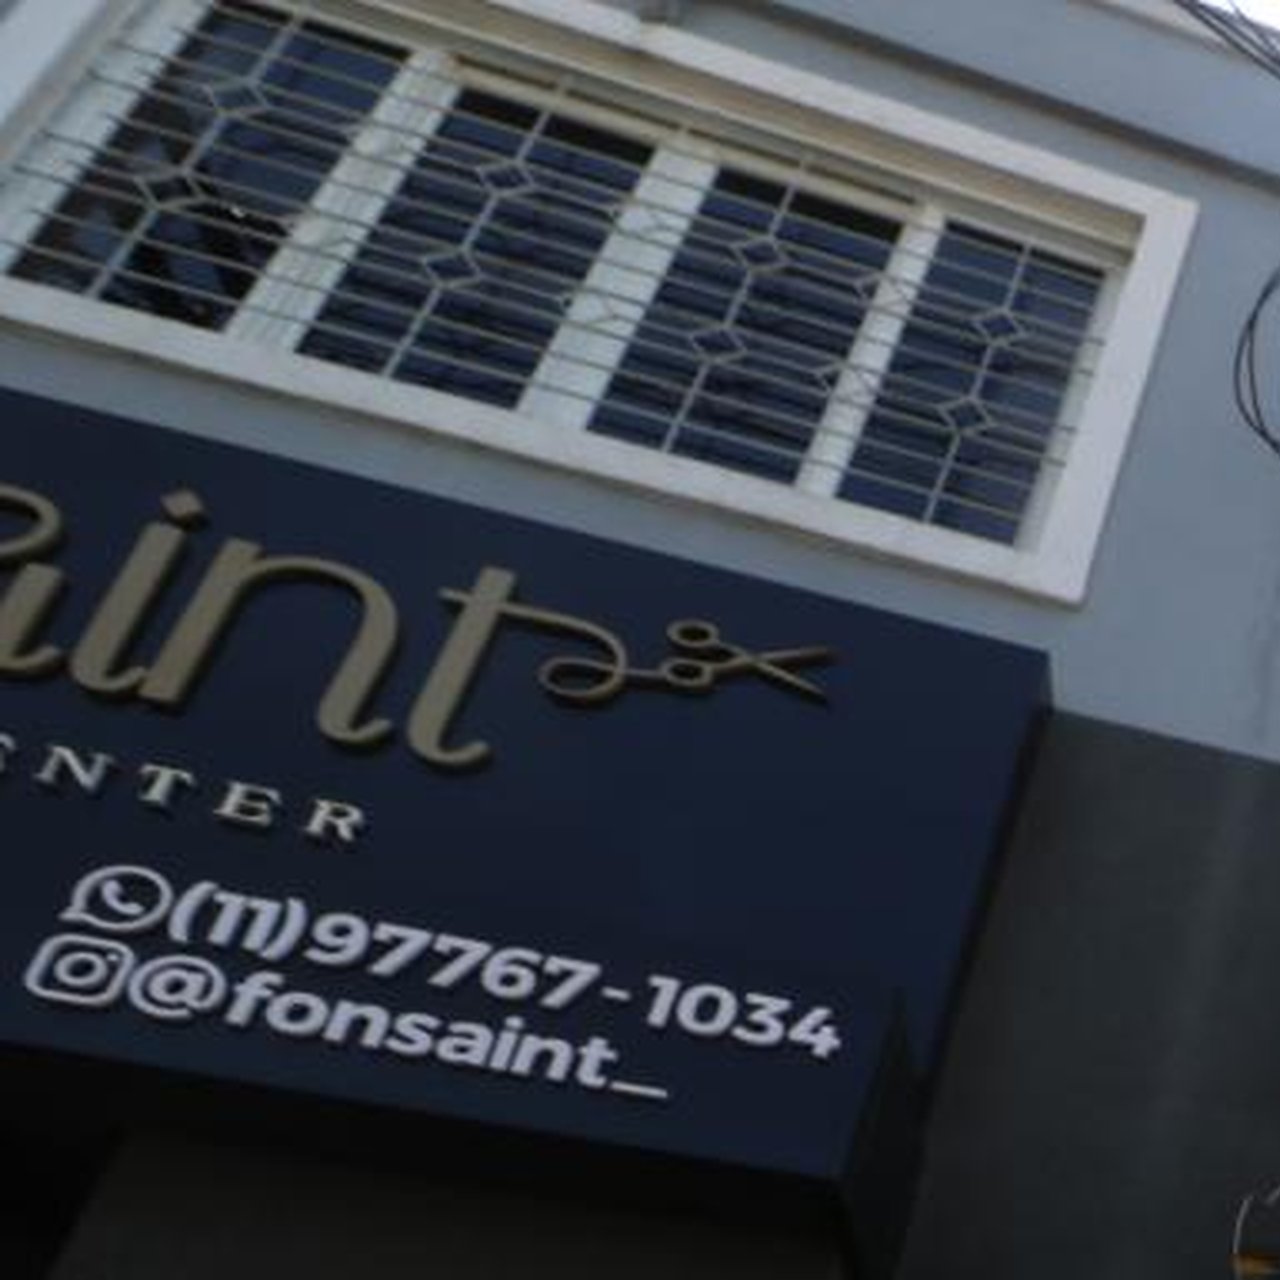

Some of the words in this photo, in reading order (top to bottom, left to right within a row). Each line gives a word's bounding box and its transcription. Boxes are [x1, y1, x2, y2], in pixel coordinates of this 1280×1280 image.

[0, 735, 366, 843] NTER
[127, 955, 667, 1098] @fonsaint_
[168, 881, 841, 1058] (11)97767-1034
